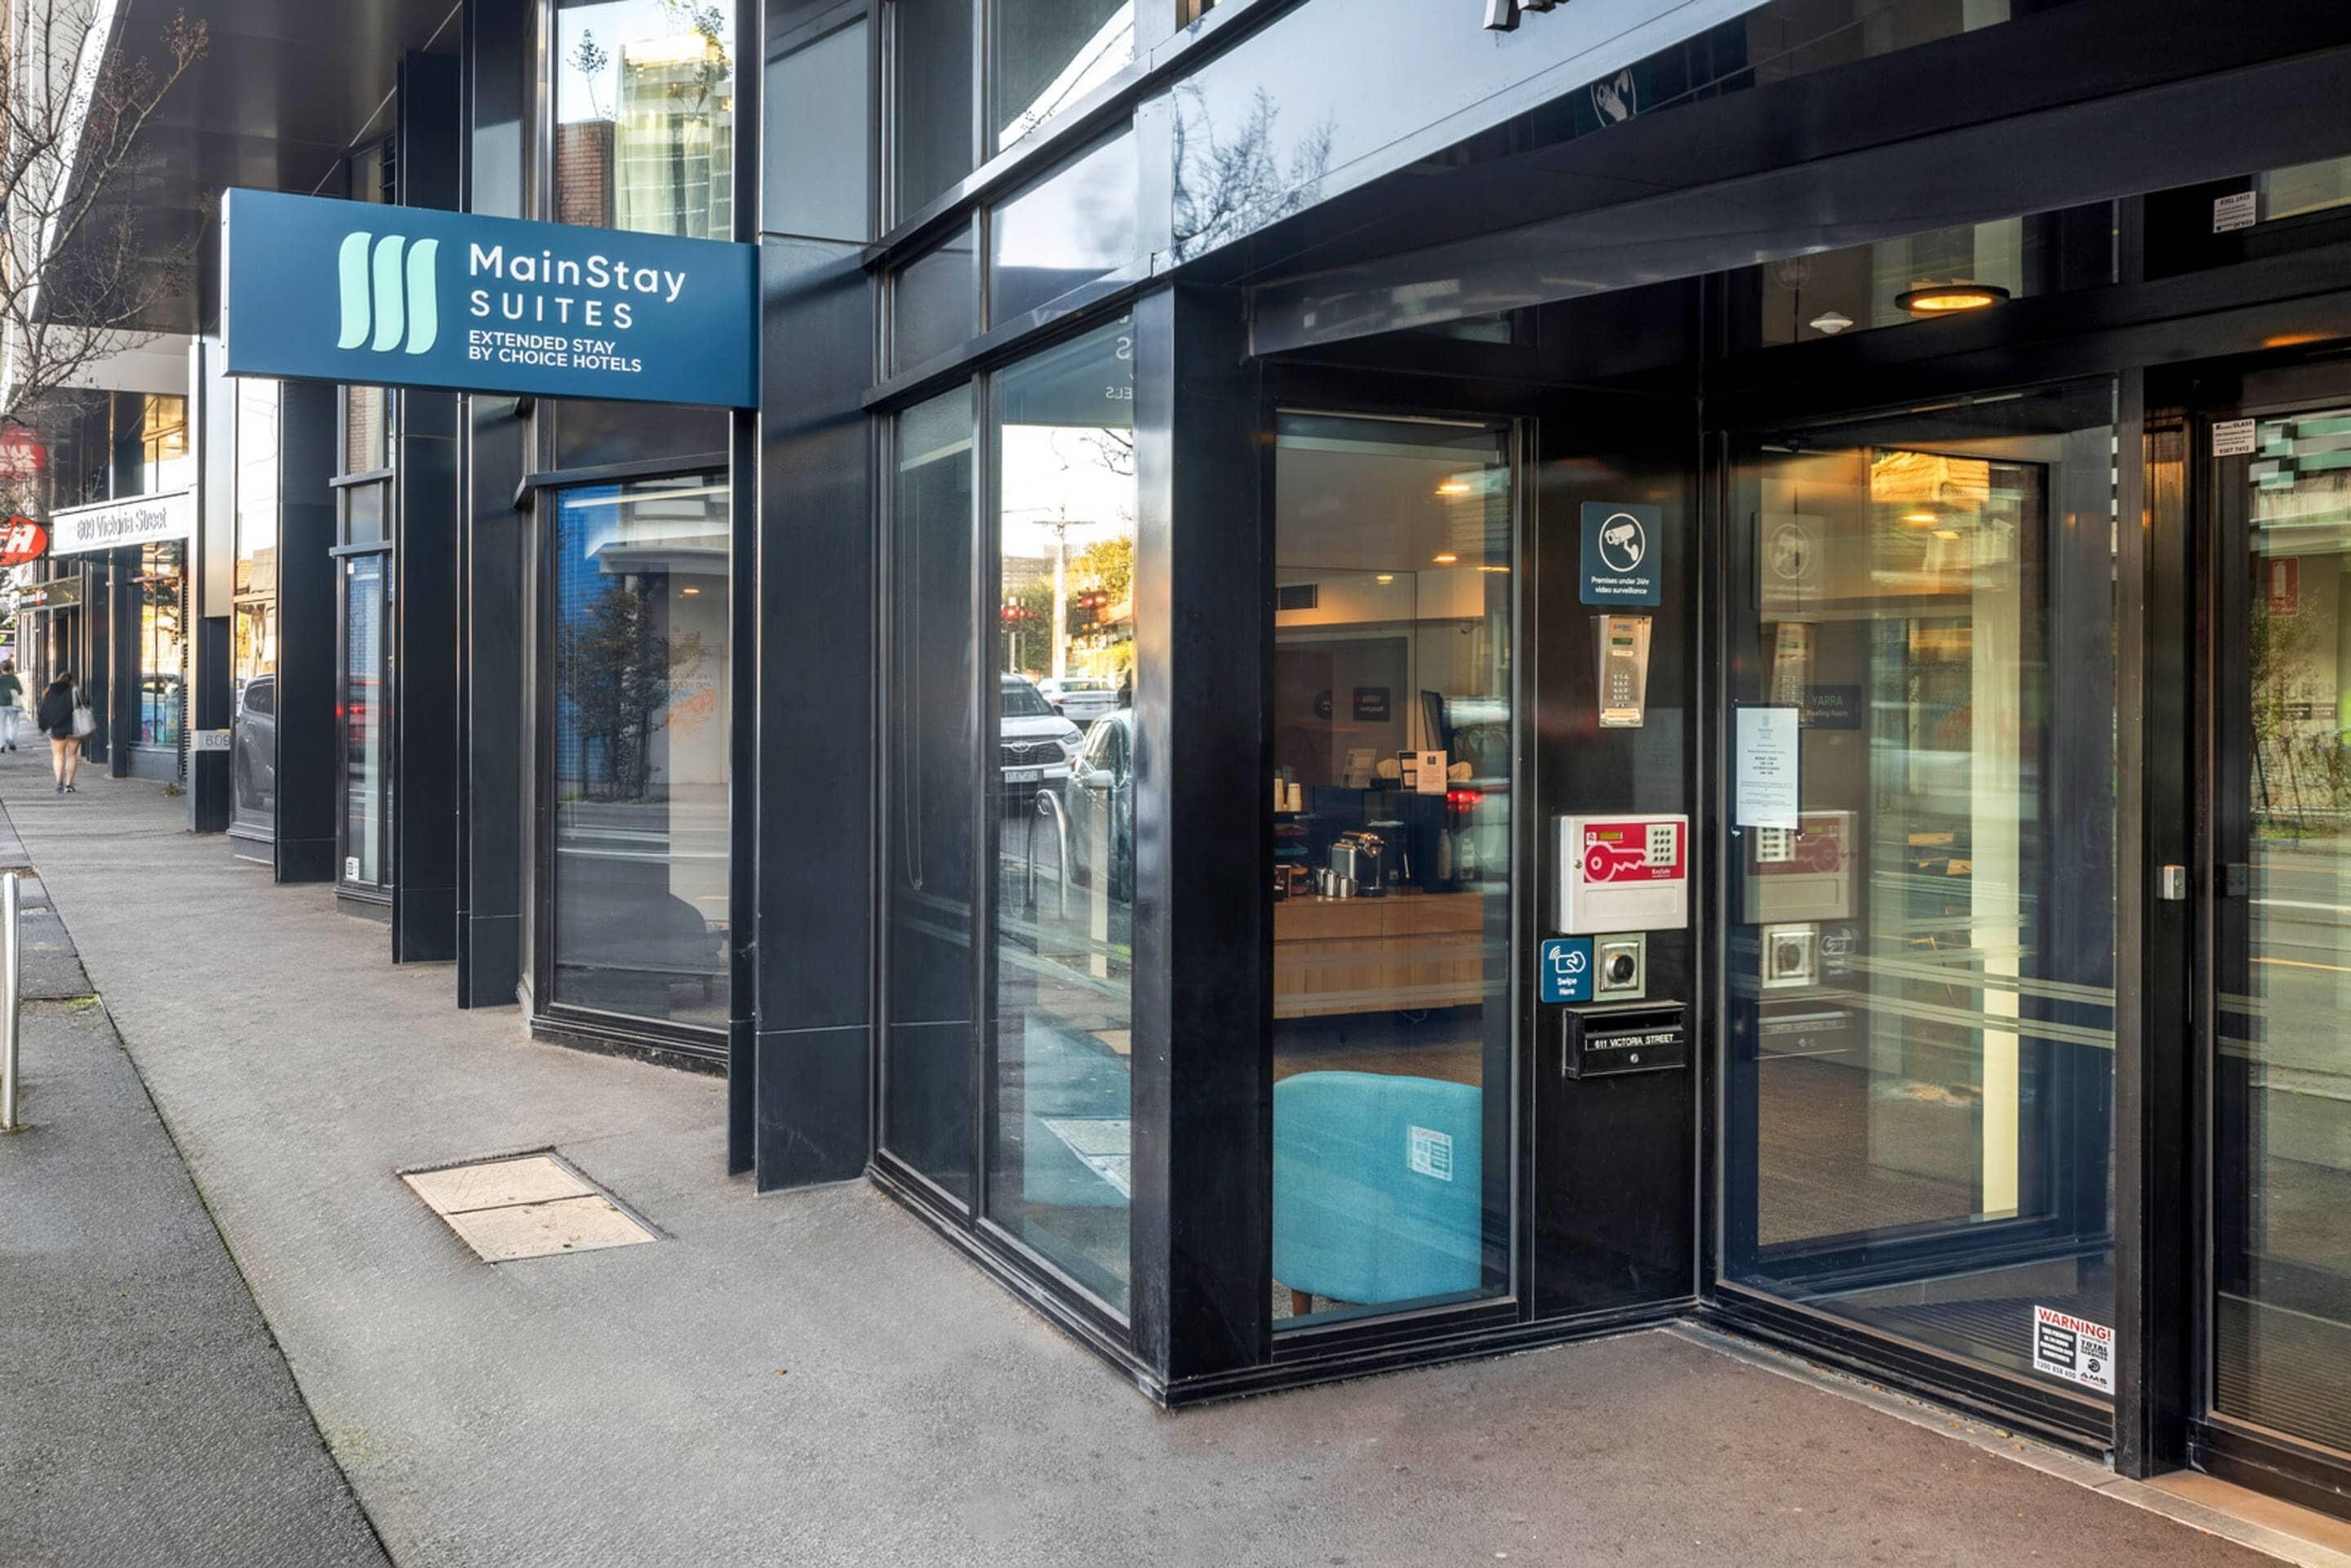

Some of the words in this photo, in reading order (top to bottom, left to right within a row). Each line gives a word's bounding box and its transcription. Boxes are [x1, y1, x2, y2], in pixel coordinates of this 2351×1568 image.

[469, 242, 687, 303] MainStay
[469, 289, 633, 330] SUITES
[469, 330, 567, 351] EXTENDED
[571, 338, 616, 354] STAY
[469, 346, 491, 361] BY
[498, 349, 568, 367] CHOICE
[573, 354, 642, 373] HOTELS
[96, 512, 134, 538] Victoria
[136, 506, 167, 531] Street
[1591, 575, 1618, 584] Premises
[1619, 577, 1636, 585] under
[1595, 585, 1612, 593] video
[1613, 586, 1647, 595] surveillance
[1810, 695, 1843, 707] YARRA
[206, 735, 229, 746] 609
[1557, 977, 1577, 987] Swipe
[1559, 988, 1575, 996] Here
[1594, 1039, 1607, 1050] 611
[1610, 1037, 1644, 1047] VICTORIA
[1645, 1033, 1674, 1045] STREET
[2038, 1308, 2111, 1342] WARNING!
[2081, 1339, 2108, 1353] TOTAL
